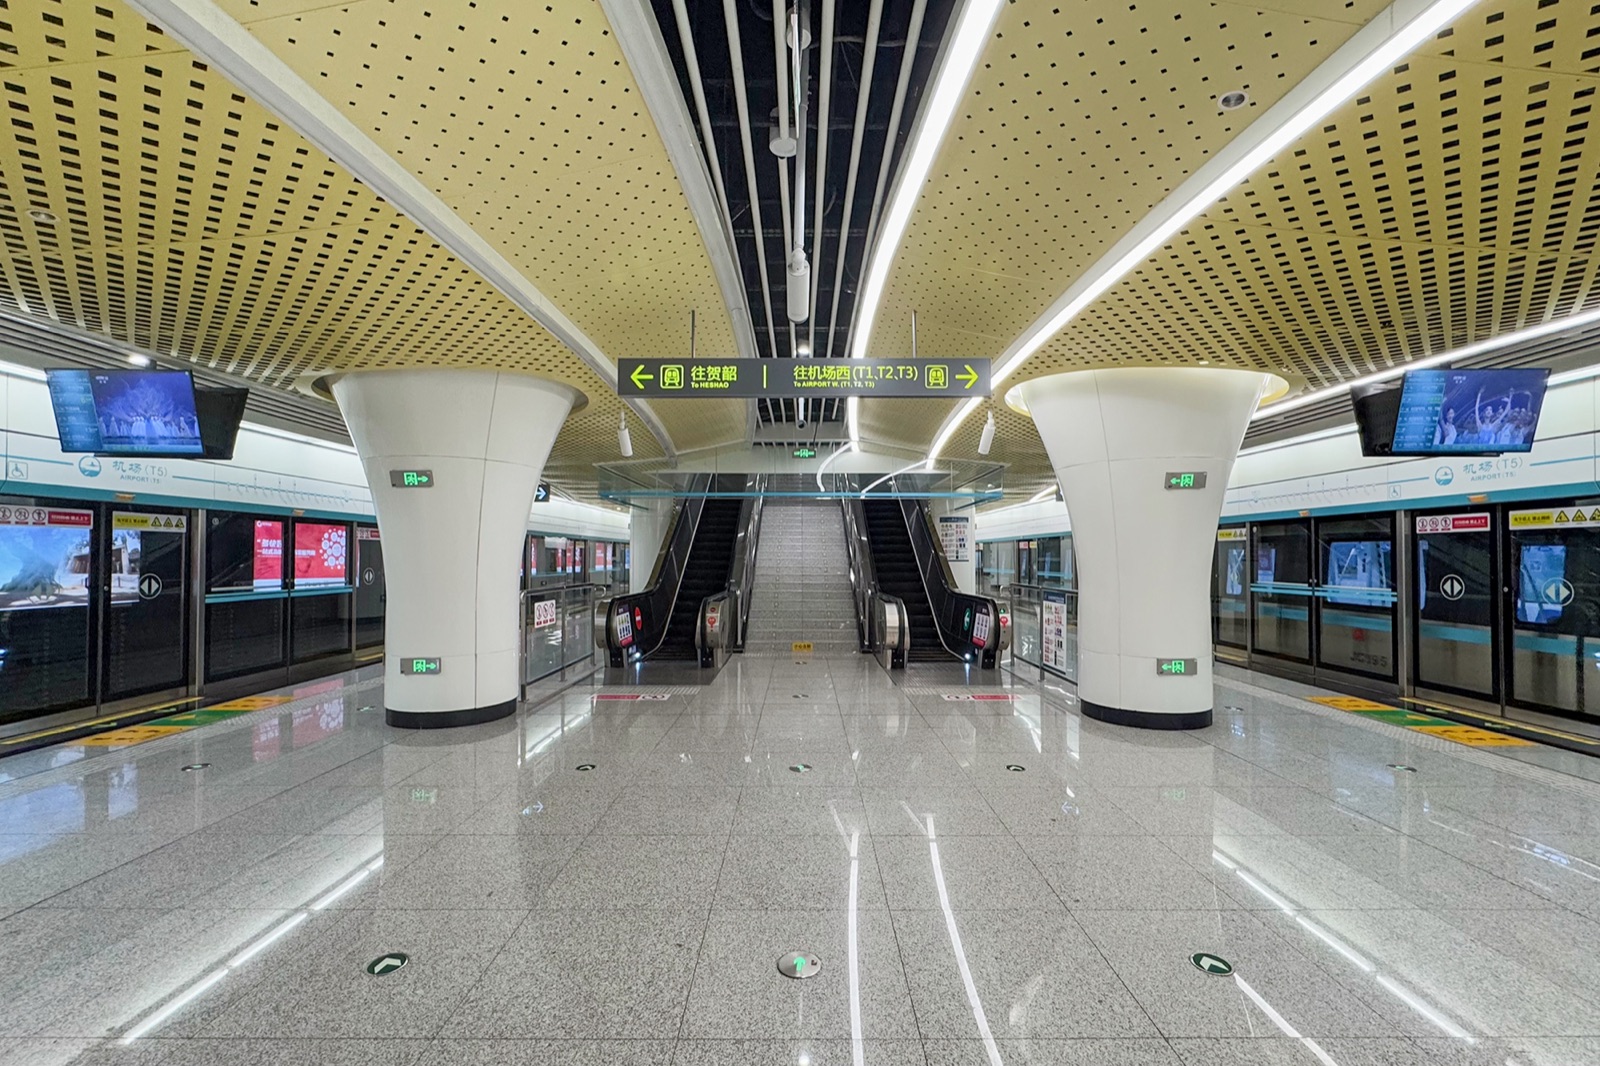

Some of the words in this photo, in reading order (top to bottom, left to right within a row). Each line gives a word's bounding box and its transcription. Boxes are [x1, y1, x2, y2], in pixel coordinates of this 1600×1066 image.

[690, 365, 738, 382] 往贺韶
[690, 381, 699, 389] To
[700, 381, 729, 389] HESHAO
[120, 474, 149, 483] AIRPORT
[1470, 472, 1501, 481] AIRPORT
